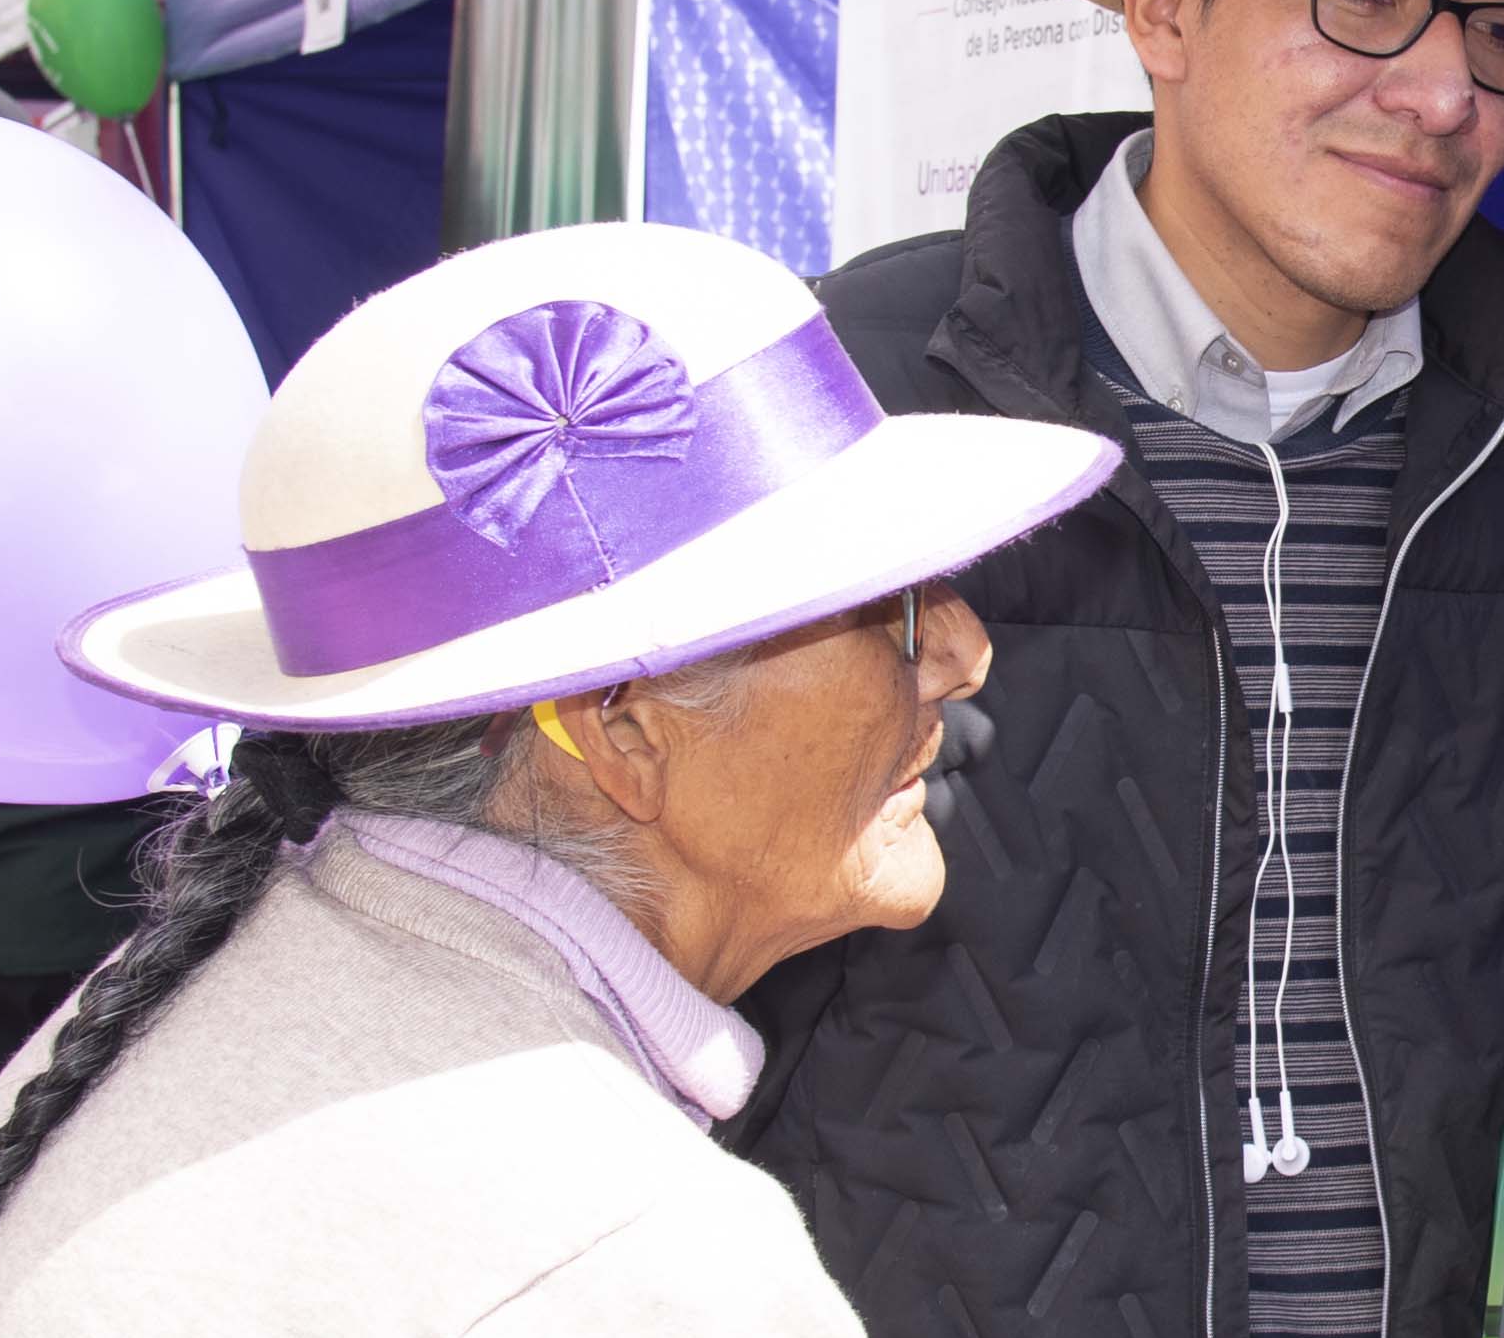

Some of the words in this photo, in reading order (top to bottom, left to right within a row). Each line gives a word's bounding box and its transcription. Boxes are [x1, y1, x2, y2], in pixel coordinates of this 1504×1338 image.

[966, 33, 983, 58] de
[986, 27, 1000, 54] la
[1004, 20, 1064, 52] Persona
